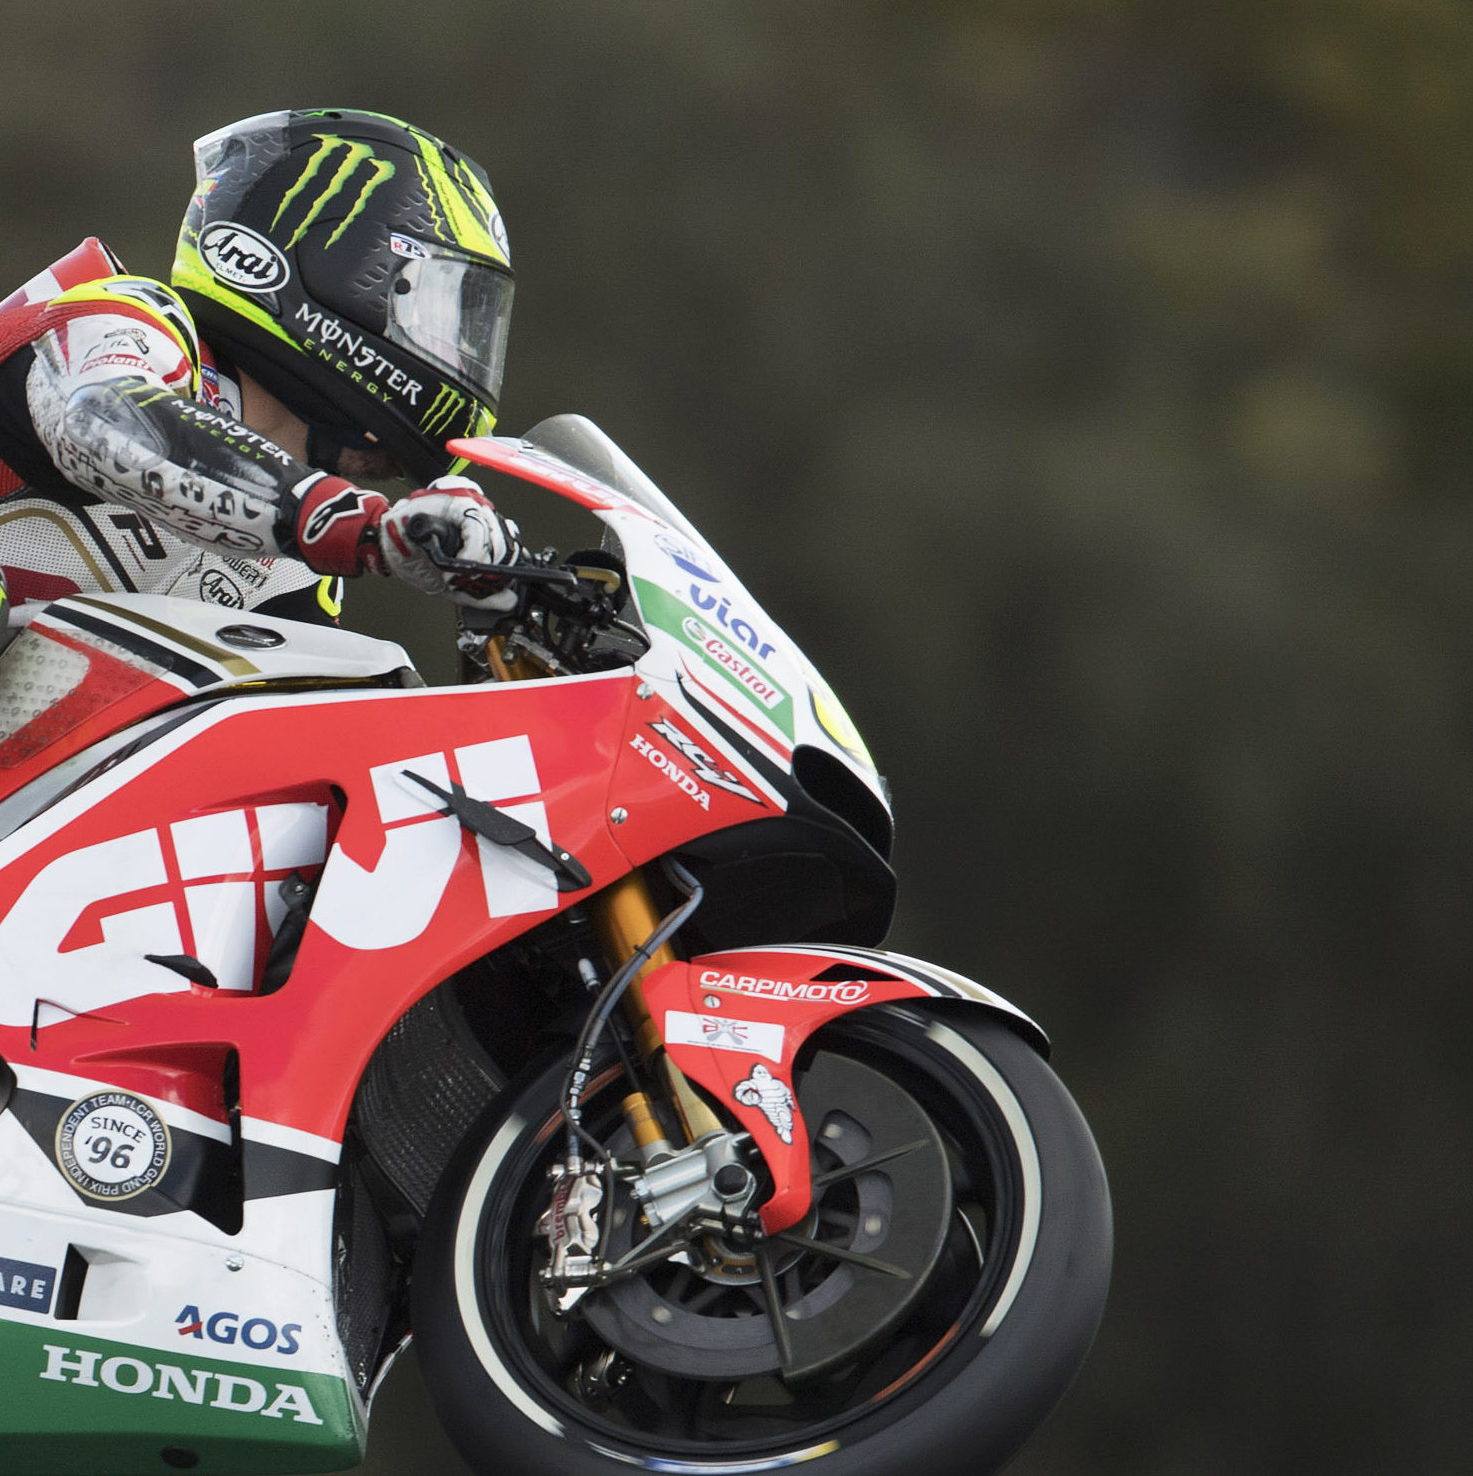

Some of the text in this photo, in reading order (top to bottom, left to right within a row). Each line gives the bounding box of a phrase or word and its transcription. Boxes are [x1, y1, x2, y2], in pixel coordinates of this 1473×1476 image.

[202, 231, 278, 280] Arai
[295, 303, 424, 406] MONSTER
[304, 339, 394, 404] ENERGY
[171, 399, 295, 467] MONSTER
[179, 414, 265, 460] ENERGY
[202, 576, 243, 610] Arai
[690, 584, 776, 660] viar
[705, 638, 777, 703] Castrol
[629, 733, 711, 811] HONDA
[700, 971, 871, 1005] CARPIMOTO
[91, 1094, 126, 1108] TEAM
[130, 1100, 156, 1122] LCR
[61, 1103, 90, 1186] INDEPENDENT
[84, 1136, 136, 1169] '96
[90, 1117, 146, 1144] SINCE
[150, 1119, 166, 1167] WORLD
[90, 1179, 120, 1196] PRIX
[174, 1304, 303, 1356] AGOS
[39, 1344, 324, 1426] HONDA
